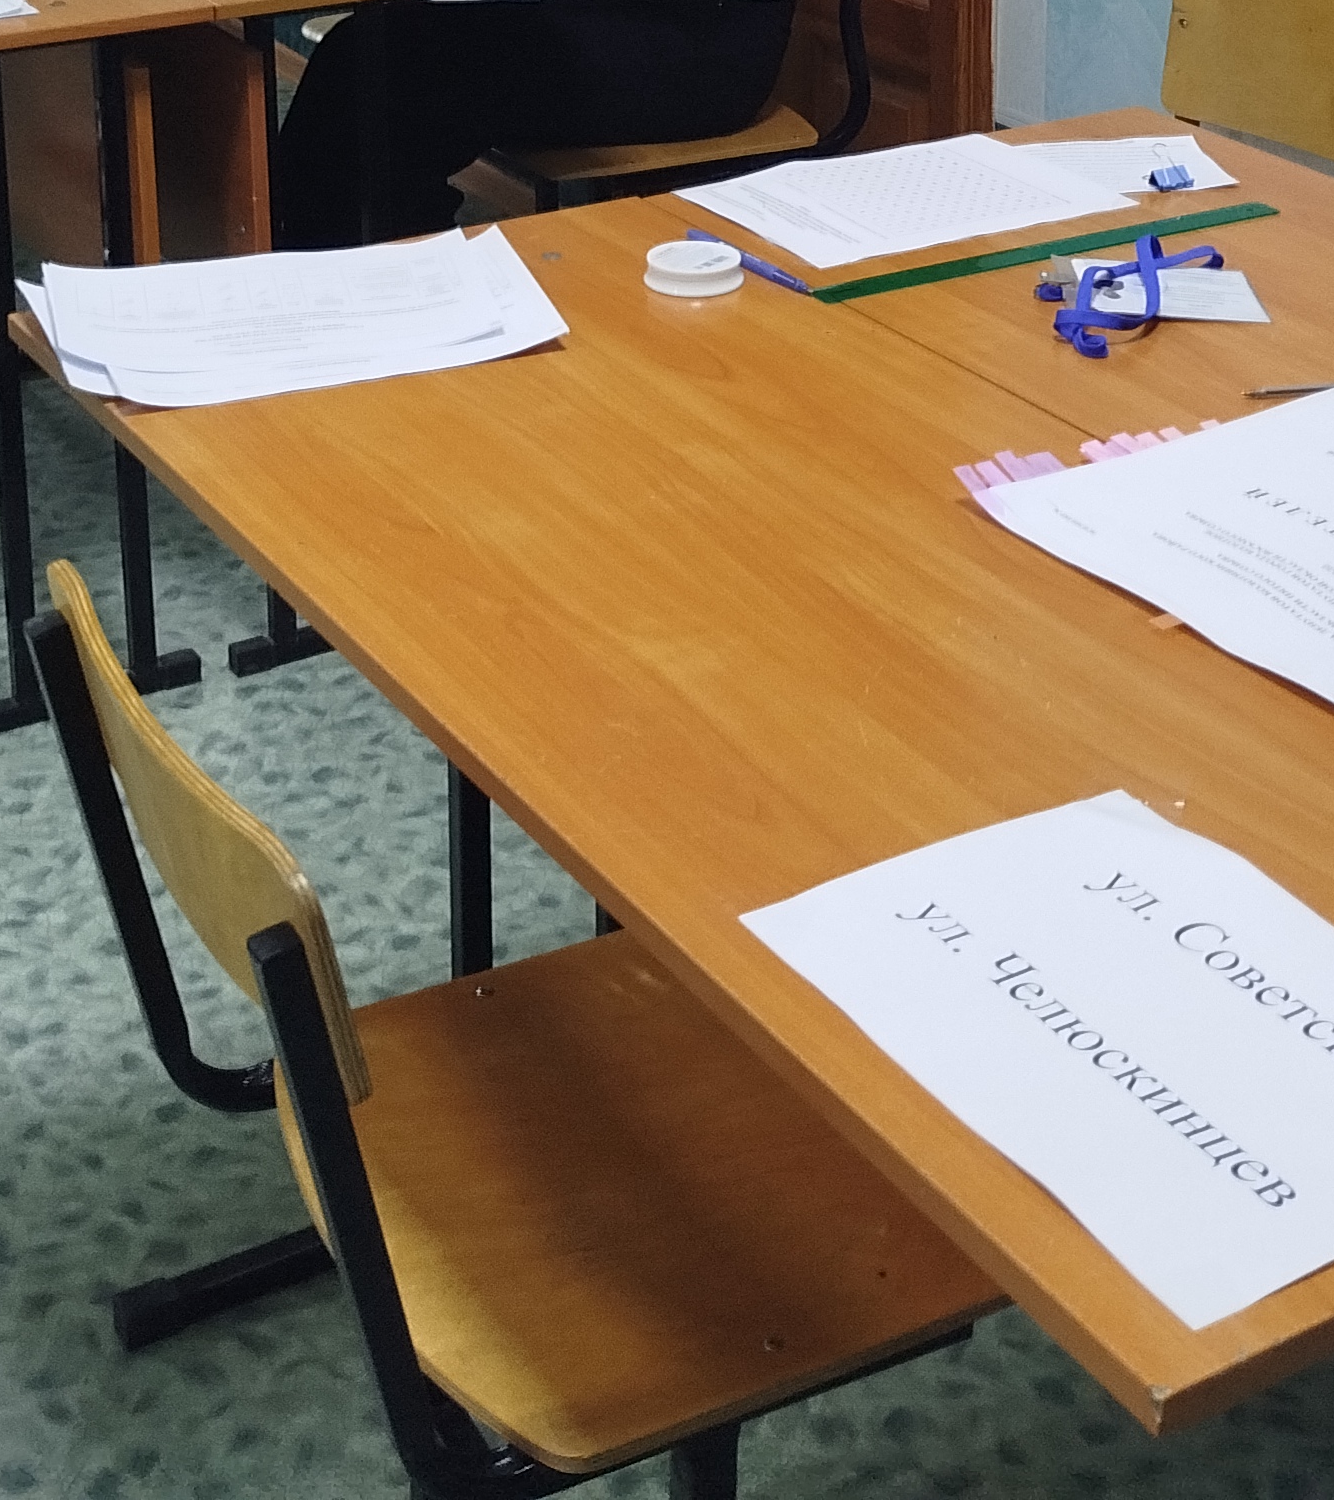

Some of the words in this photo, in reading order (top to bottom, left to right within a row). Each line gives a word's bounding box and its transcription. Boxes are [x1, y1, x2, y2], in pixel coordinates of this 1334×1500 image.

[1082, 870, 1155, 924] ул.
[894, 901, 965, 955] ул.
[989, 950, 1301, 1211] Челюскинцев
